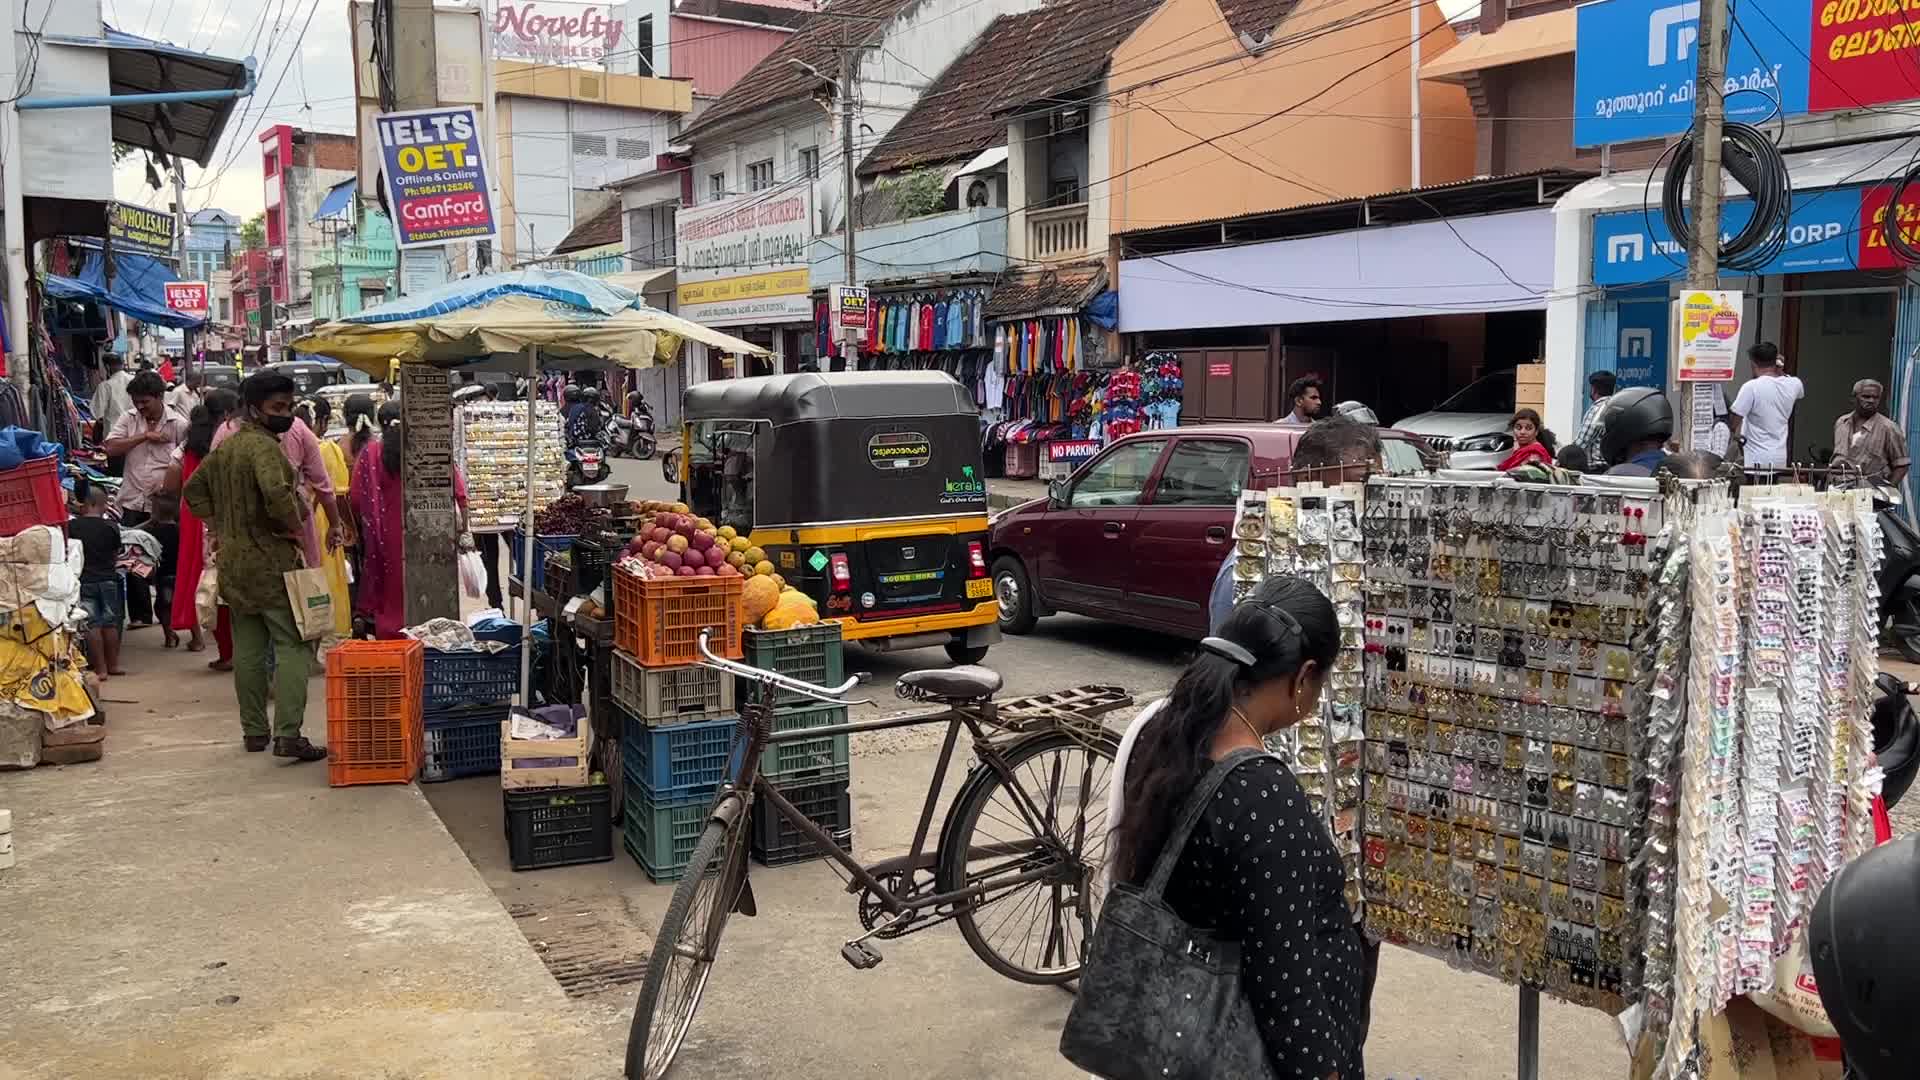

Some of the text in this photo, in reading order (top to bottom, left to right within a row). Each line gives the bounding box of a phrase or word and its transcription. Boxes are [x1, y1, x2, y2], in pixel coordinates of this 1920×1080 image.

[494, 3, 624, 48] Novelty
[380, 114, 473, 146] IELTS
[396, 170, 479, 186] Offline & Online
[403, 194, 484, 220] Camford
[119, 206, 172, 236] WHOLESALE
[171, 289, 202, 299] IELTS
[840, 288, 867, 298] IELTS
[175, 299, 200, 308] OET
[1052, 444, 1100, 457] NO PARKING
